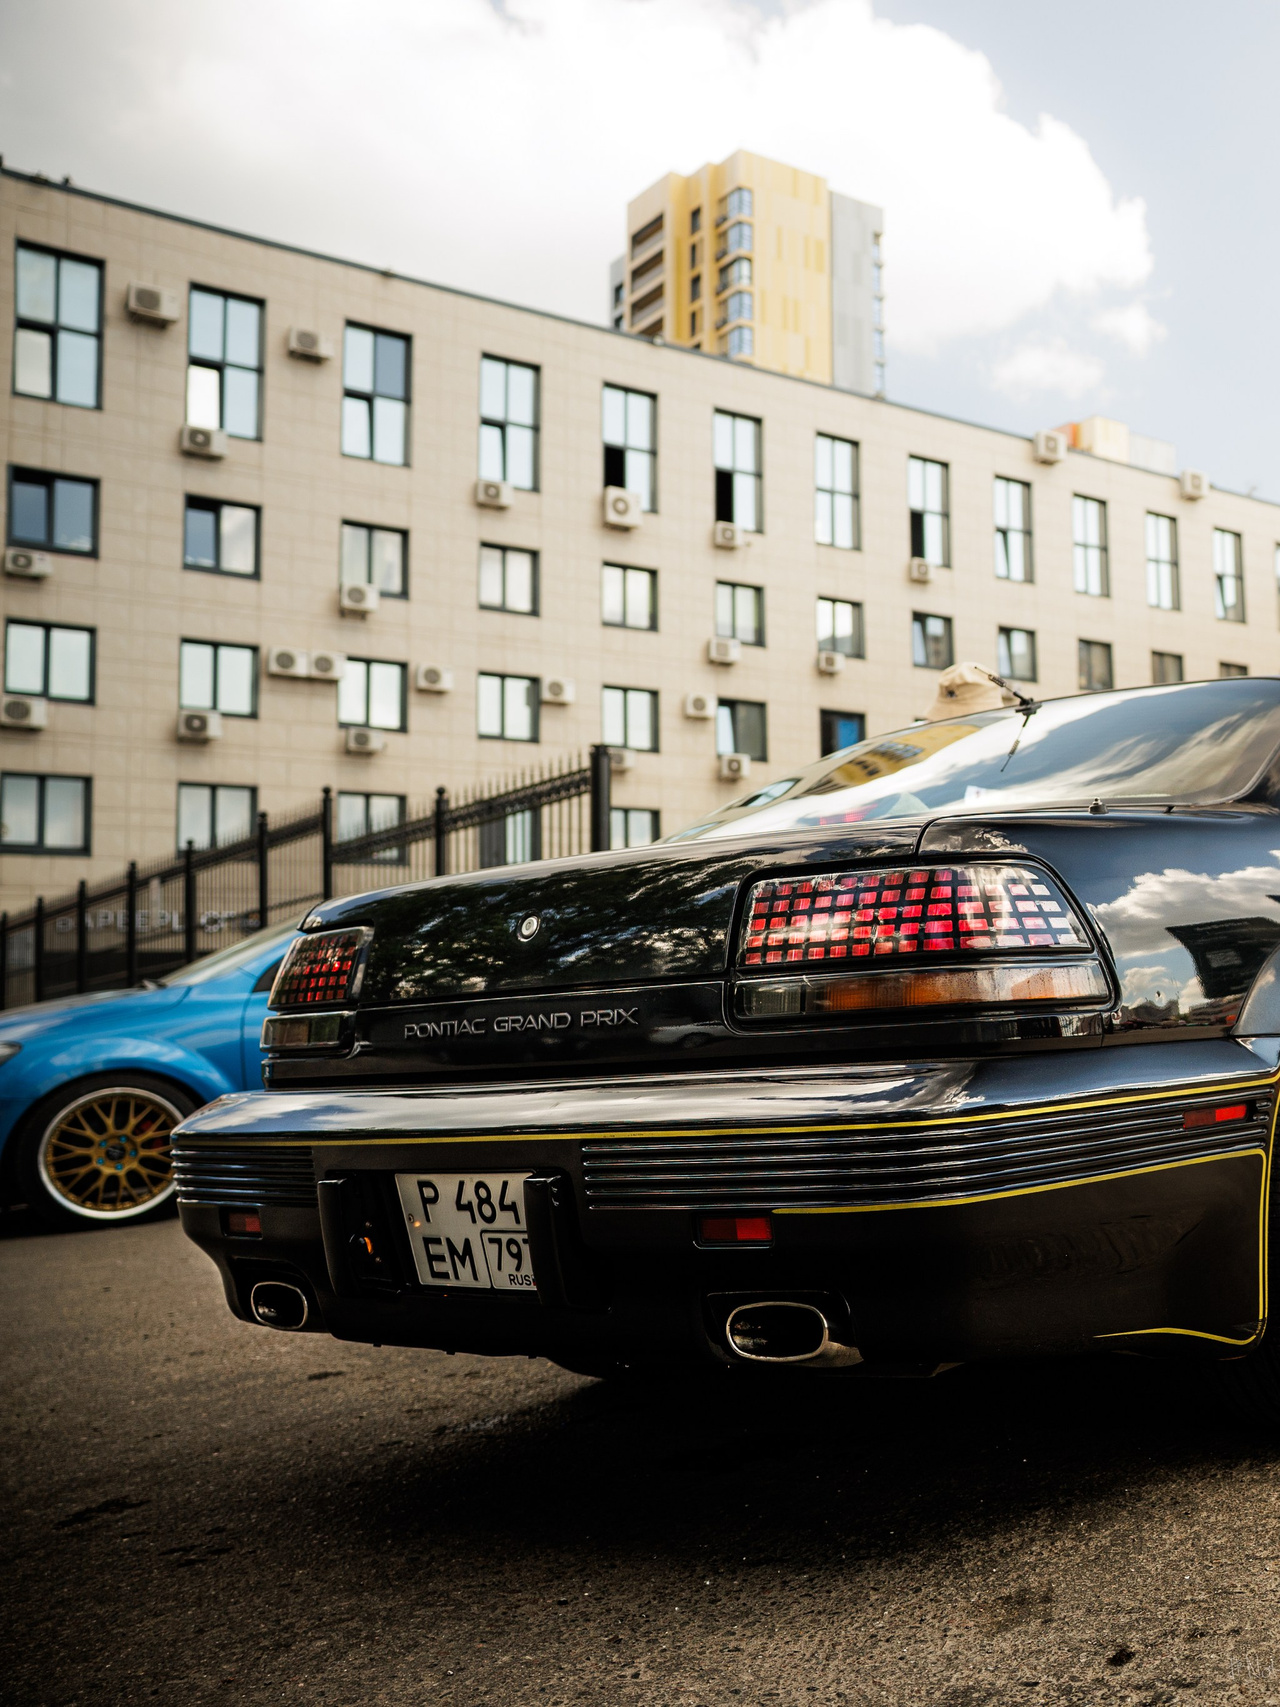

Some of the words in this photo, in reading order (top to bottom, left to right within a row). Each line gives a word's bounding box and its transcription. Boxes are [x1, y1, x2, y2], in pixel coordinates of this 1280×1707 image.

[404, 1018, 487, 1039] PONTIAC
[493, 1011, 571, 1033] GRAND
[580, 1007, 639, 1027] PRIX
[455, 1180, 521, 1224] 484
[508, 1273, 532, 1287] RUS
